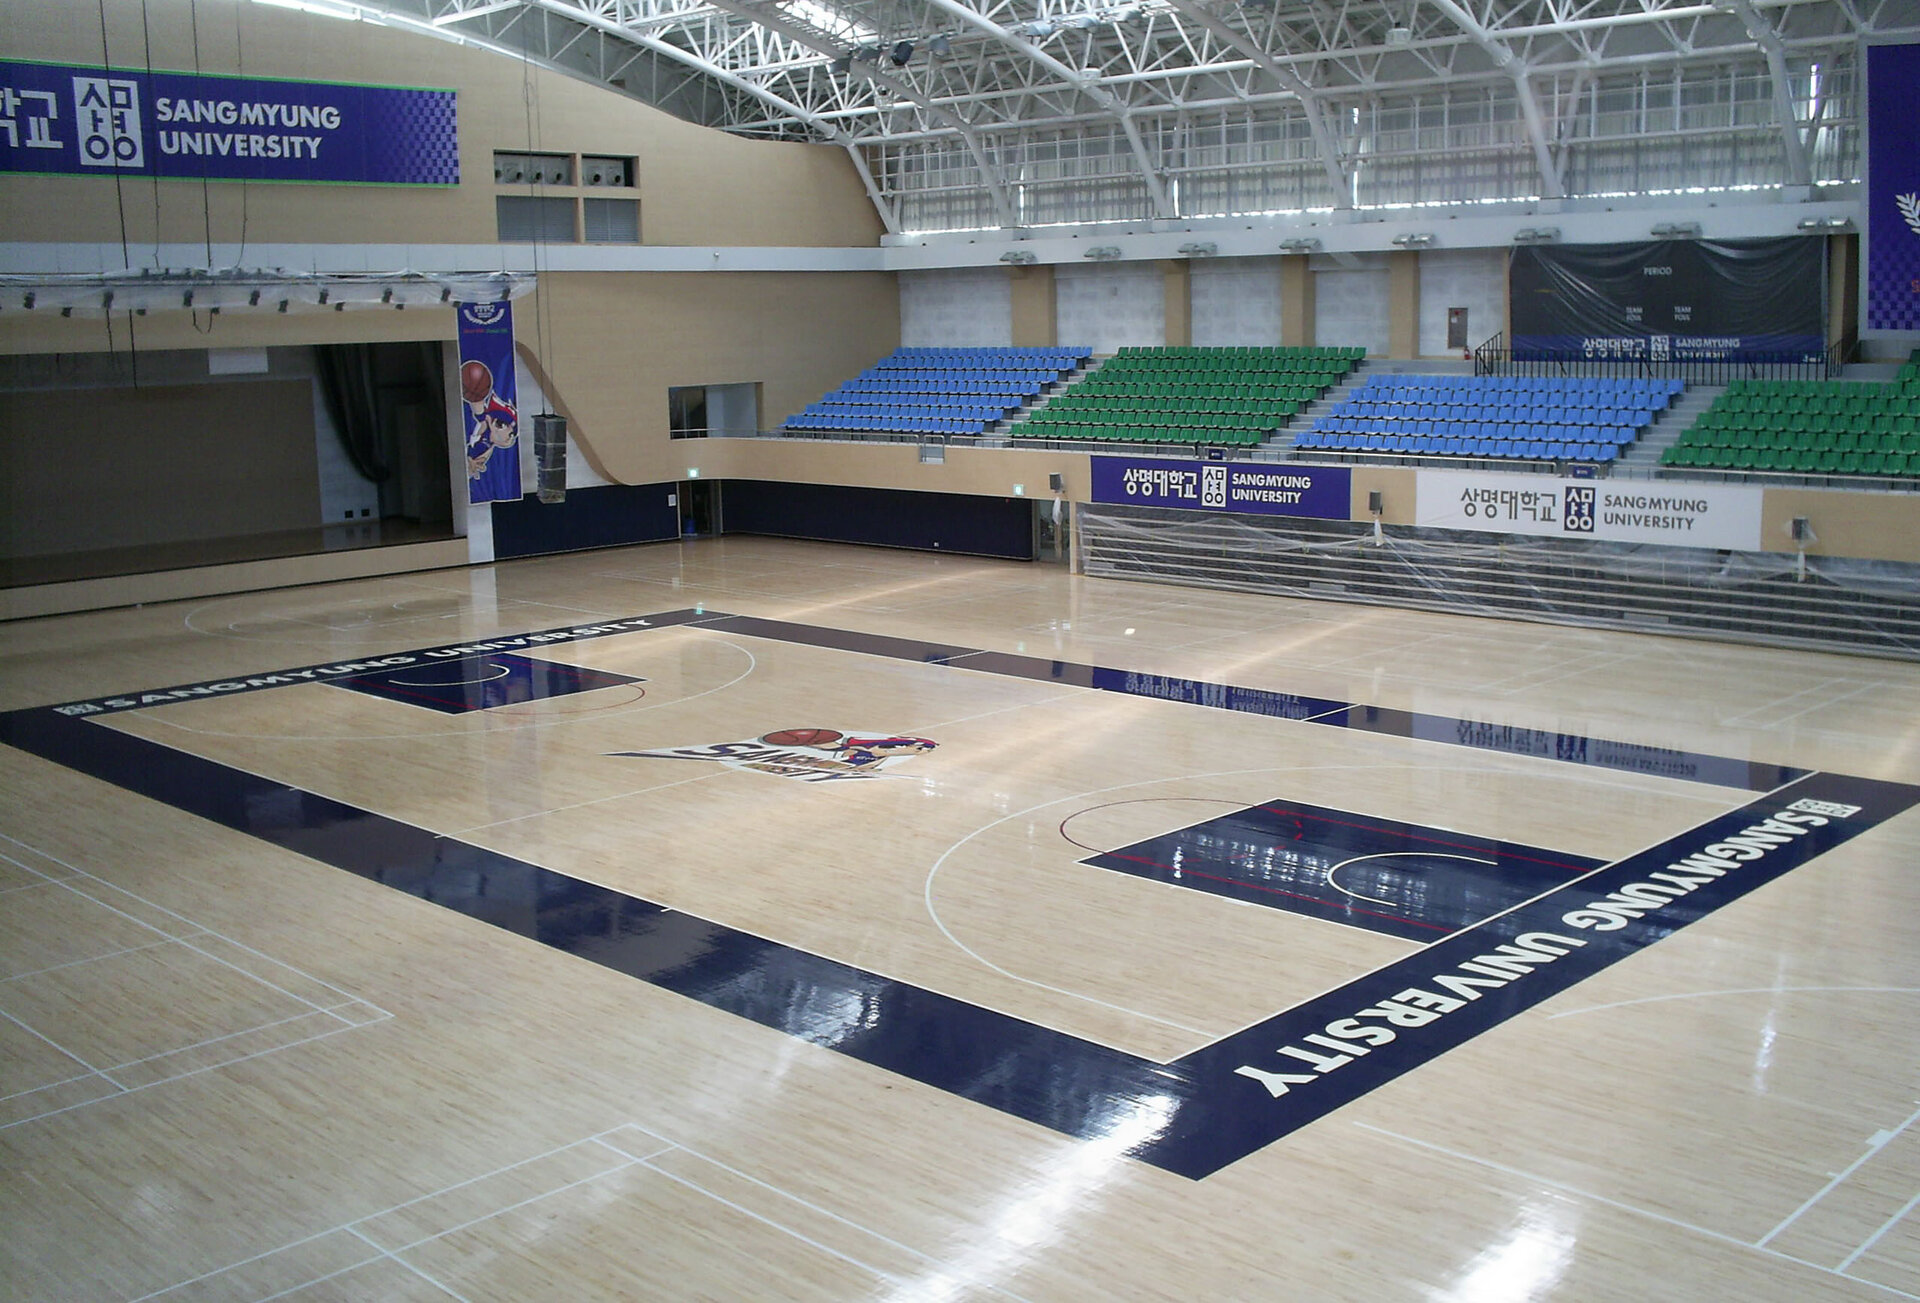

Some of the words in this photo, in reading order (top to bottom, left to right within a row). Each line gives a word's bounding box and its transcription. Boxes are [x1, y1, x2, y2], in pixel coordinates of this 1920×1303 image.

[156, 97, 341, 130] SANGMYUNG
[159, 131, 323, 159] UNIVERSITY
[1643, 266, 1673, 276] PERIOD
[1675, 338, 1741, 348] SANGMYUNG
[1123, 468, 1198, 498] 상명대학교
[1232, 473, 1311, 490] SANGMYUNG
[1232, 488, 1302, 504] UNIVERSITY
[1461, 487, 1557, 522] 상명대학교
[1604, 495, 1708, 513] SANGMYUNG
[1604, 512, 1695, 531] UNIVERSITY
[104, 655, 416, 708] SANGMYUNG
[424, 618, 652, 658] UNIVERSITY
[1562, 807, 1829, 932] SANGMYUNG
[1234, 931, 1588, 1099] UNIVERSITY
